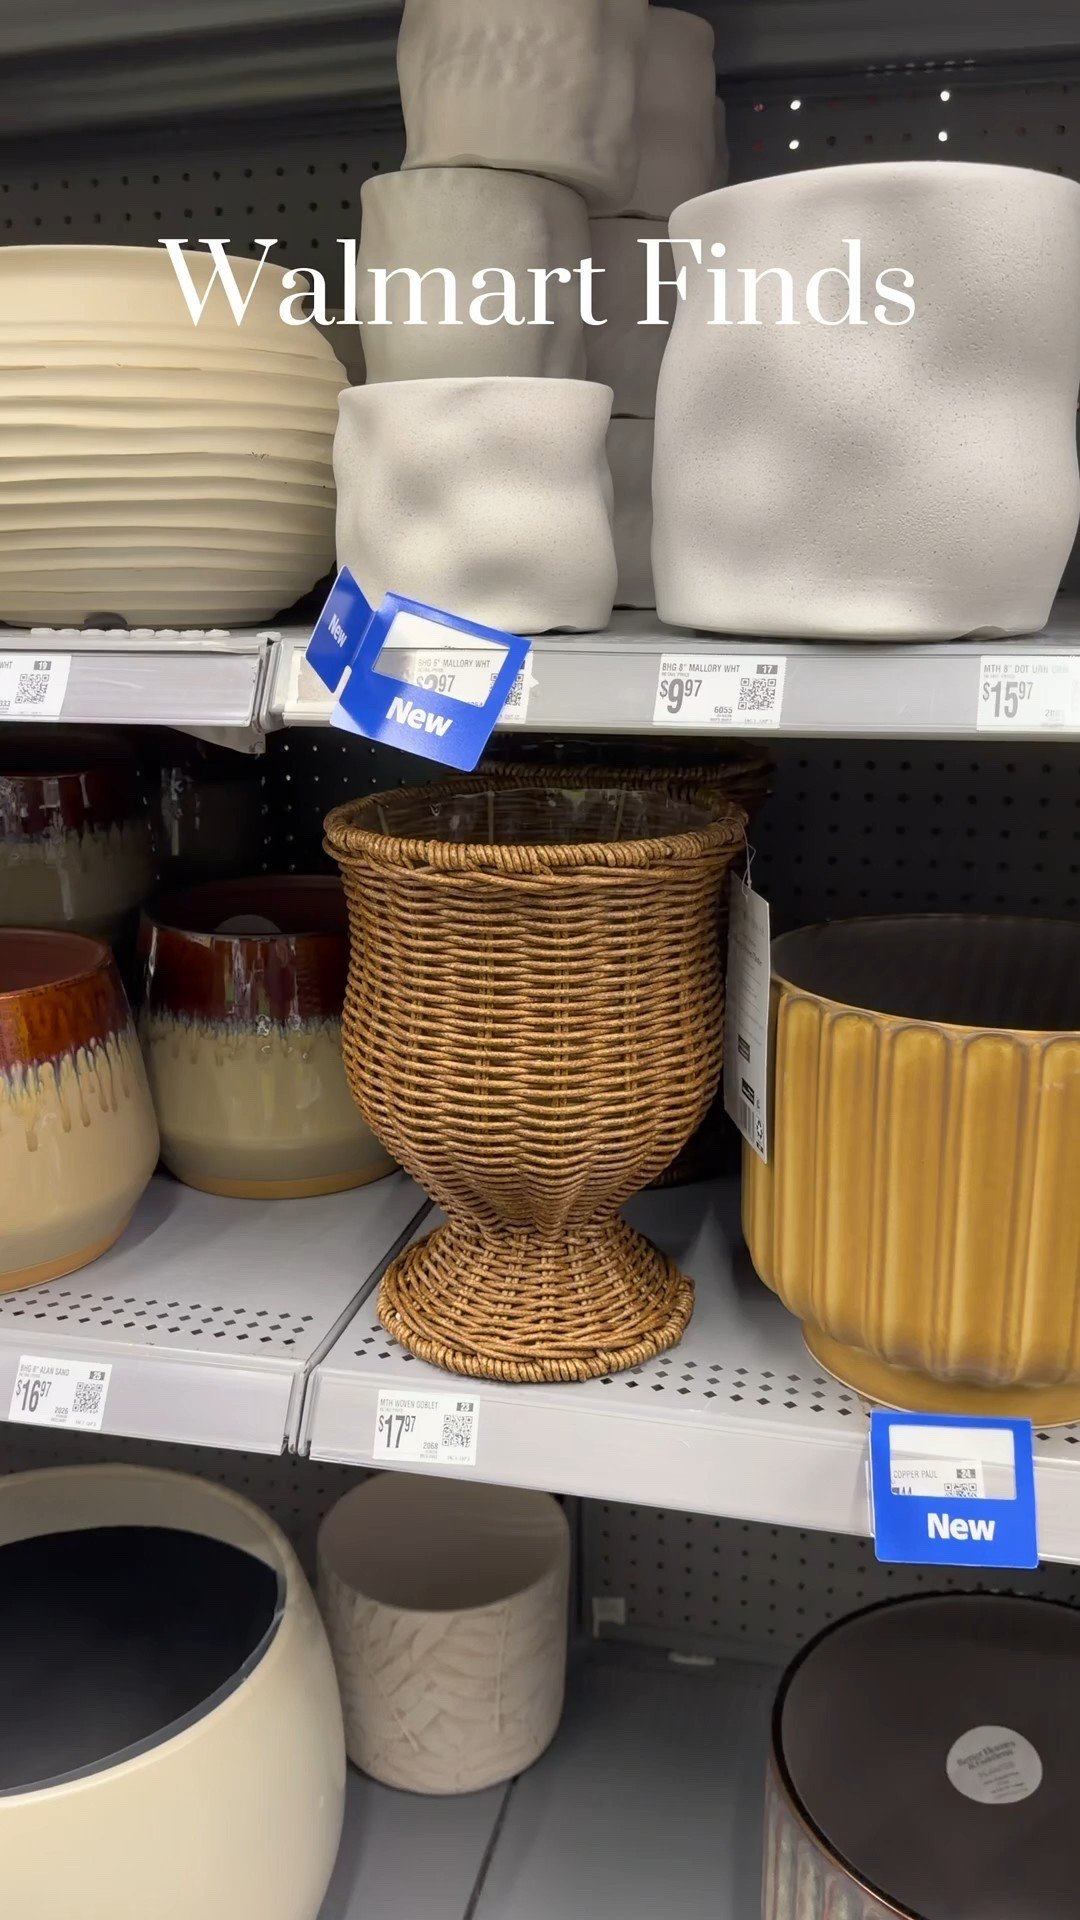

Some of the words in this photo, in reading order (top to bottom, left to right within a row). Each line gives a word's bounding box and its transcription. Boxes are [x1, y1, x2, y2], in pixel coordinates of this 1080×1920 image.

[328, 613, 348, 649] New
[443, 659, 474, 668] MALLORY
[475, 660, 491, 669] WHT
[662, 663, 677, 672] BHG
[689, 664, 722, 673] MALLORY
[724, 665, 741, 673] WHT
[984, 664, 1001, 673] MTH
[1015, 665, 1030, 673] DOT
[714, 706, 733, 714] 6055
[385, 696, 454, 737] New
[40, 1366, 54, 1375] ALAN
[380, 1399, 393, 1407] MTH
[395, 1400, 415, 1408] WOVEN
[416, 1401, 439, 1409] GOBLET
[423, 1442, 439, 1450] 2068
[921, 1469, 938, 1479] PAUL
[927, 1512, 996, 1541] New
